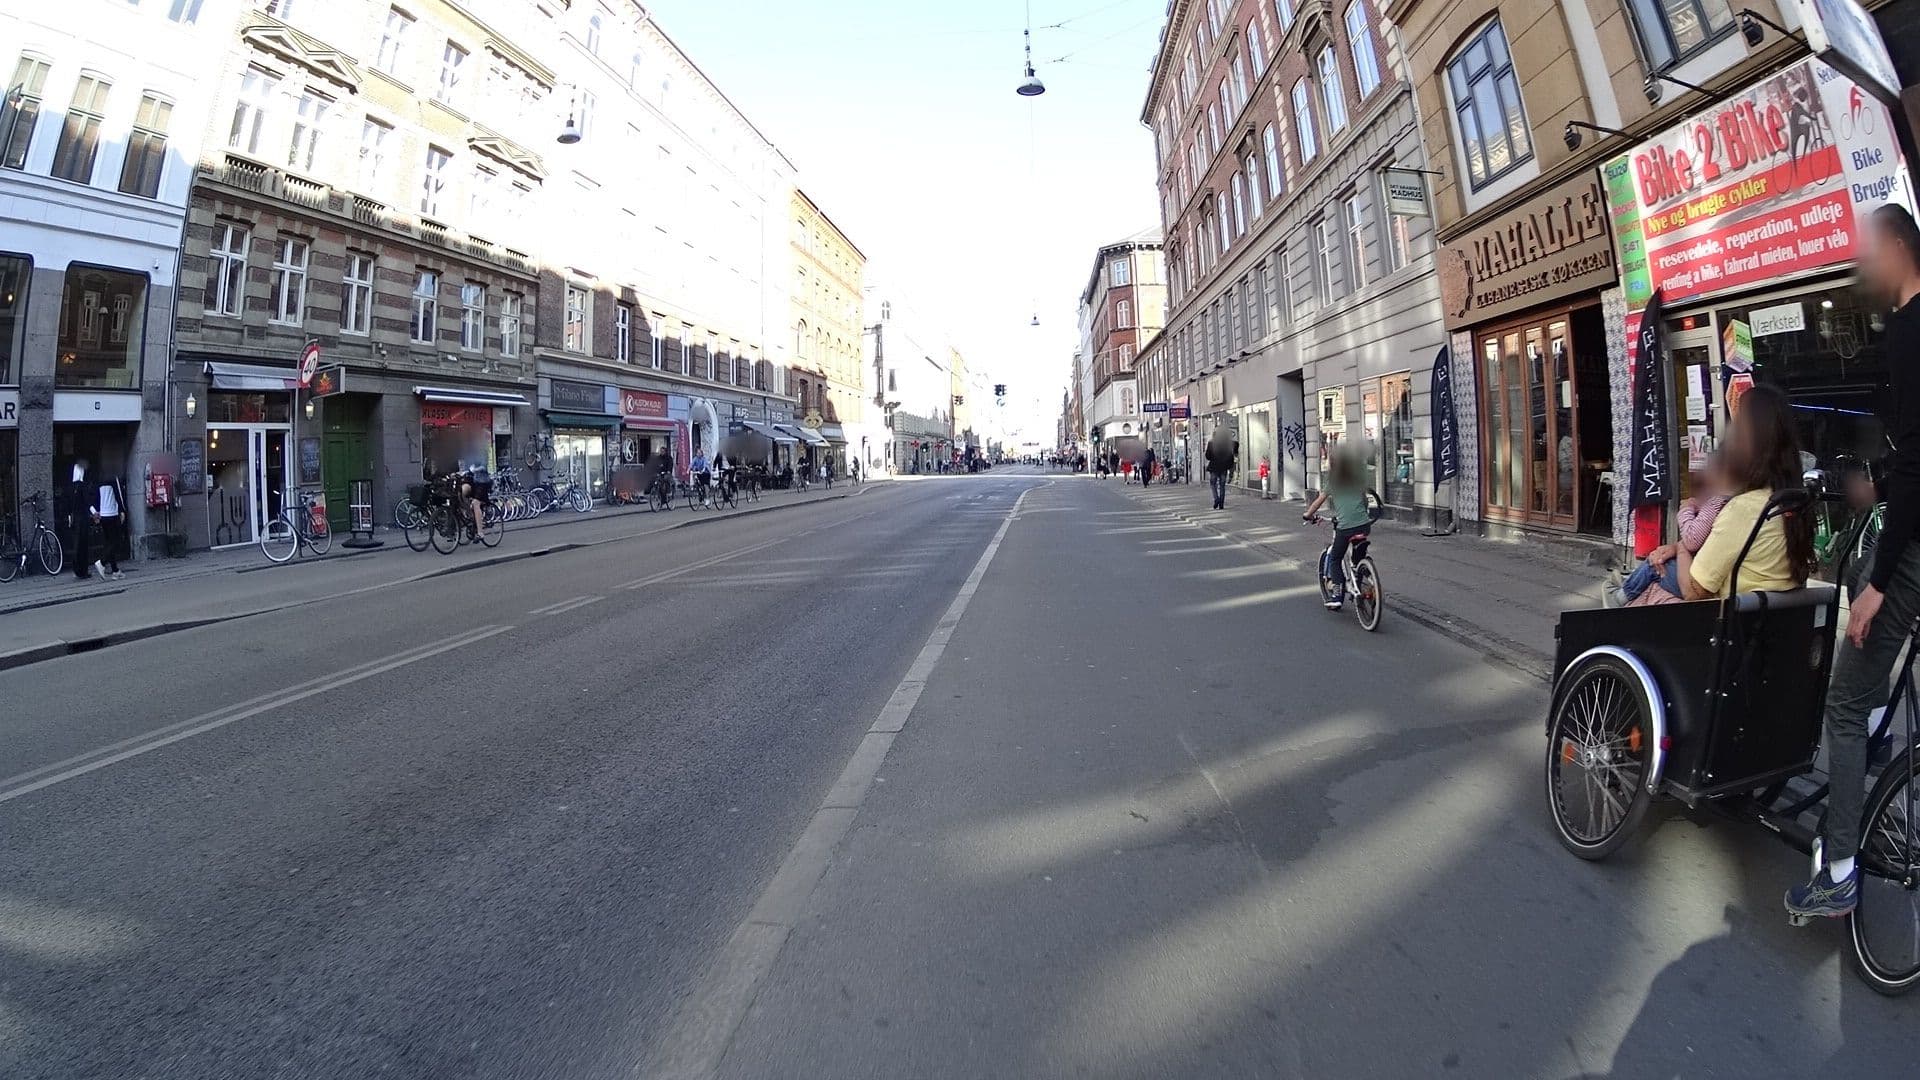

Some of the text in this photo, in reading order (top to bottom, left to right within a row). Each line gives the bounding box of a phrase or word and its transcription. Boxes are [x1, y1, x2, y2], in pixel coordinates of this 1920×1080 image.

[1635, 101, 1789, 207] Bike 2 Bike
[1852, 147, 1883, 170] Bike
[1390, 189, 1423, 198] MADHUS
[1647, 215, 1668, 233] Nye
[1671, 210, 1687, 226] og
[1687, 194, 1727, 217] brugte
[1729, 178, 1767, 205] cykler
[1852, 175, 1898, 203] Brugte
[1474, 183, 1605, 282] MAHALLE
[1725, 216, 1798, 250] reperation,
[1801, 201, 1844, 228] udleje
[1552, 250, 1610, 284] KØKKEN
[1663, 272, 1693, 291] renting
[1693, 270, 1700, 282] a
[1724, 253, 1759, 275] fahrrad
[1761, 244, 1797, 266] mieten,
[1799, 237, 1825, 256] louer
[1828, 228, 1849, 249] vélo
[1752, 311, 1801, 334] Værksted
[0, 402, 16, 419] R
